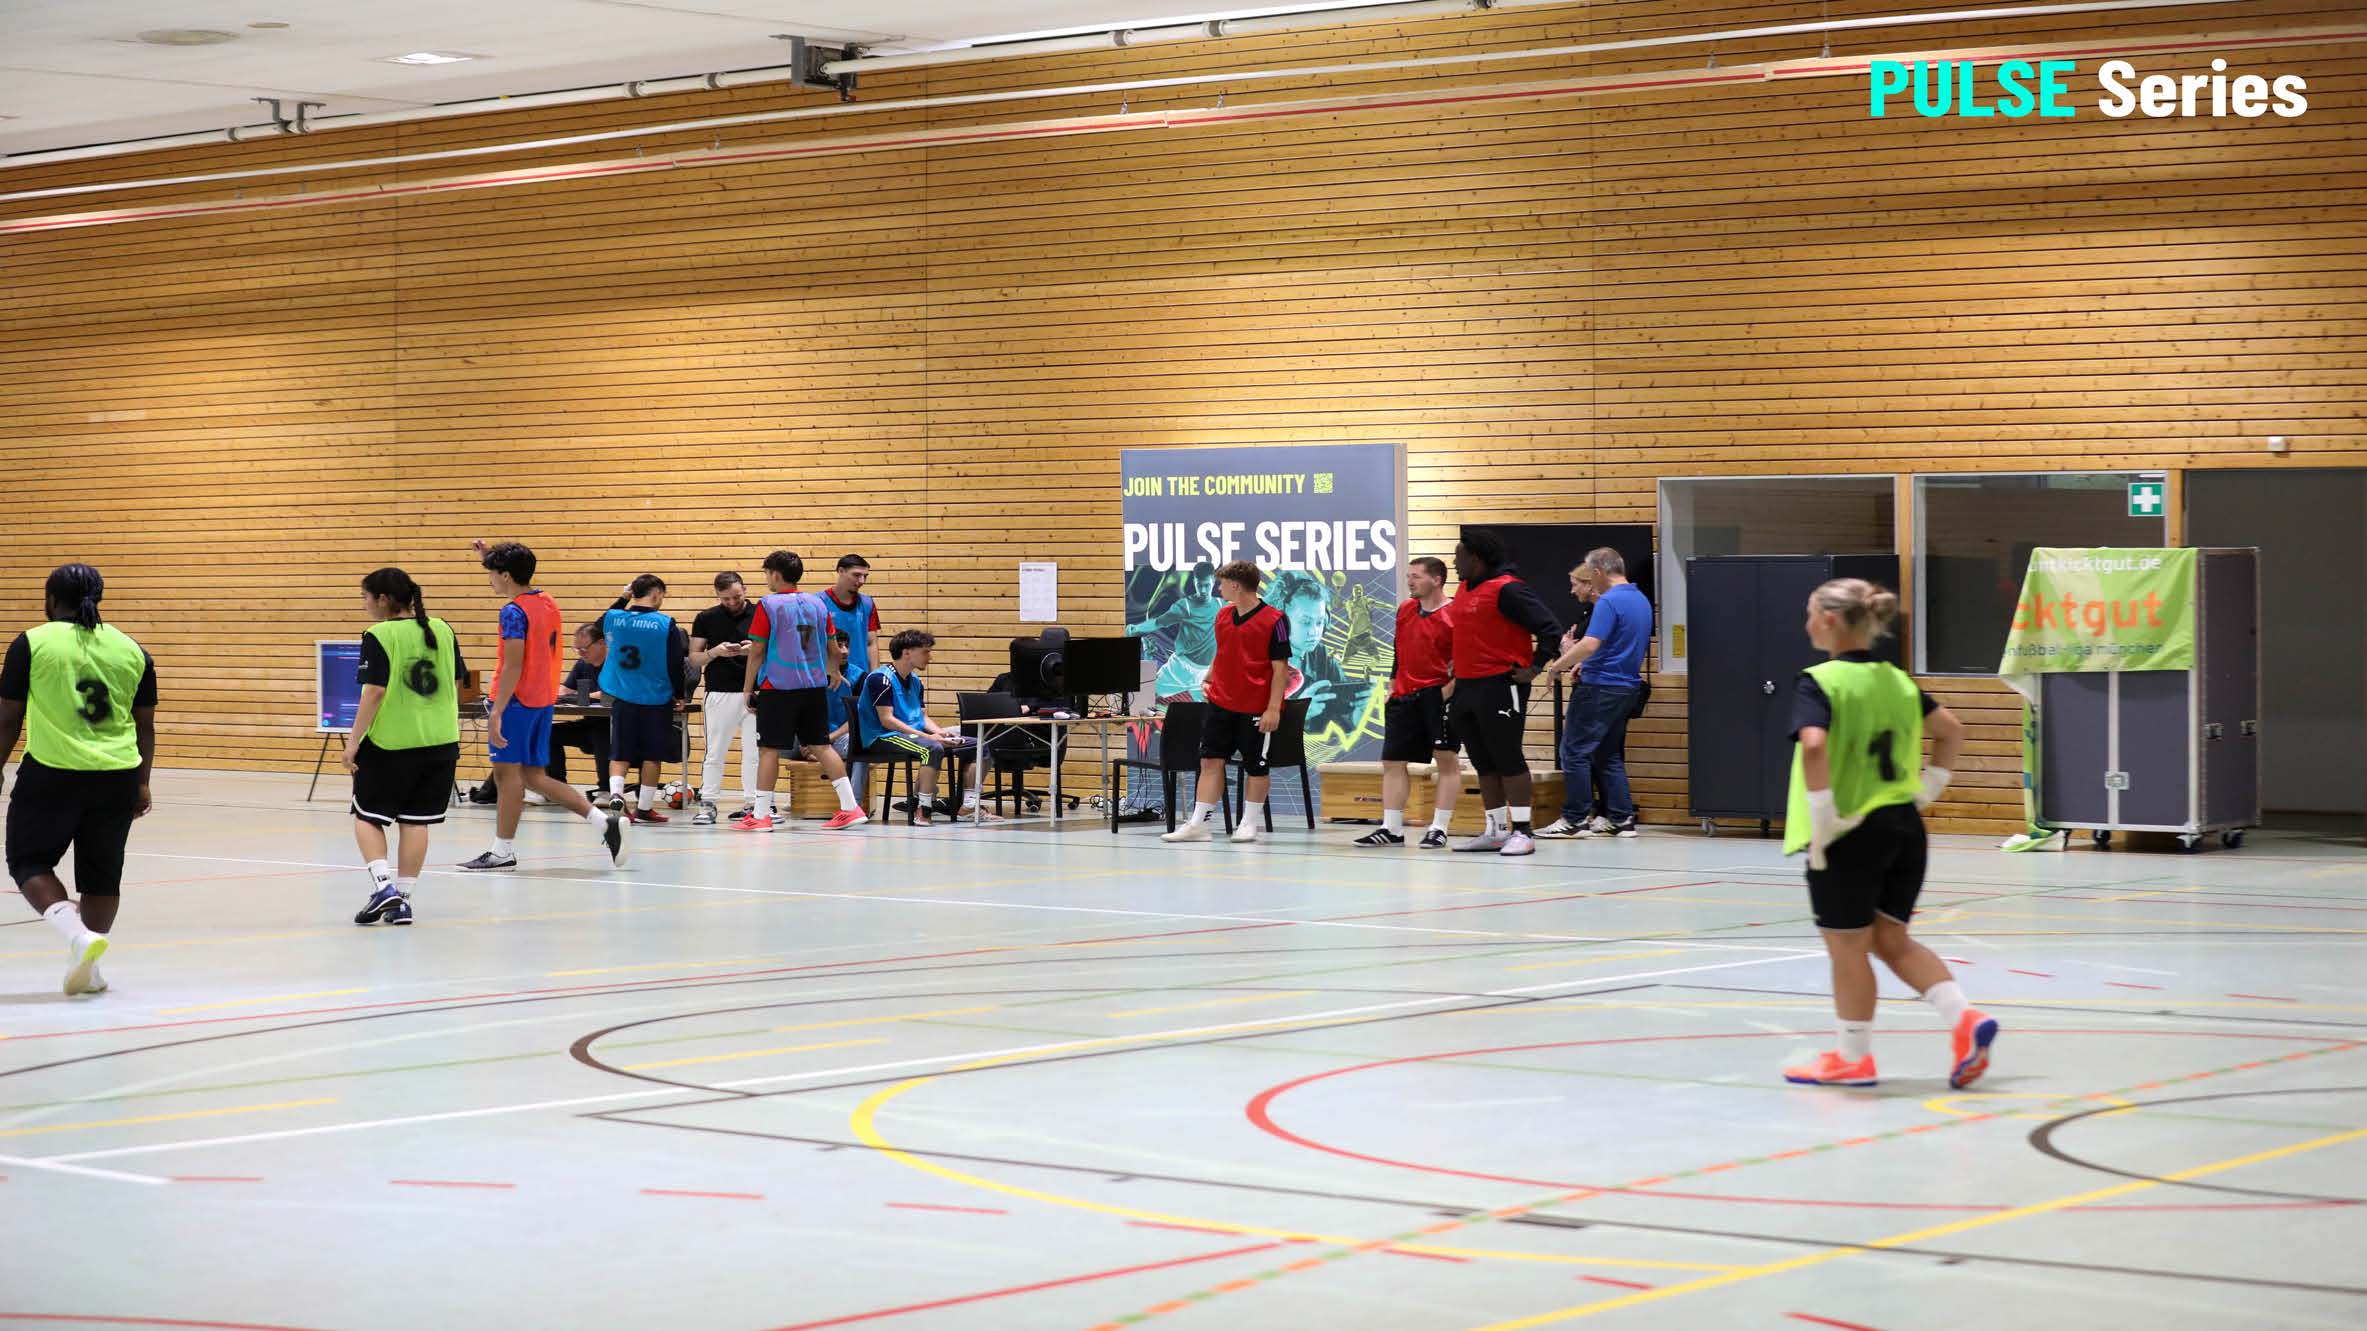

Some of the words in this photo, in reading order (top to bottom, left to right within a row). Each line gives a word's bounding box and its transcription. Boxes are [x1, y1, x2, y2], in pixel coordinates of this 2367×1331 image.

[1123, 477, 1162, 497] JOIN
[1167, 475, 1200, 496] THE
[1204, 473, 1306, 496] COMMUNITY
[1124, 522, 1245, 572] PULSE
[1255, 519, 1397, 571] SERIES
[406, 659, 439, 696] 6
[620, 645, 641, 670] 3
[76, 680, 112, 723] 3
[1867, 729, 1897, 780] 1
